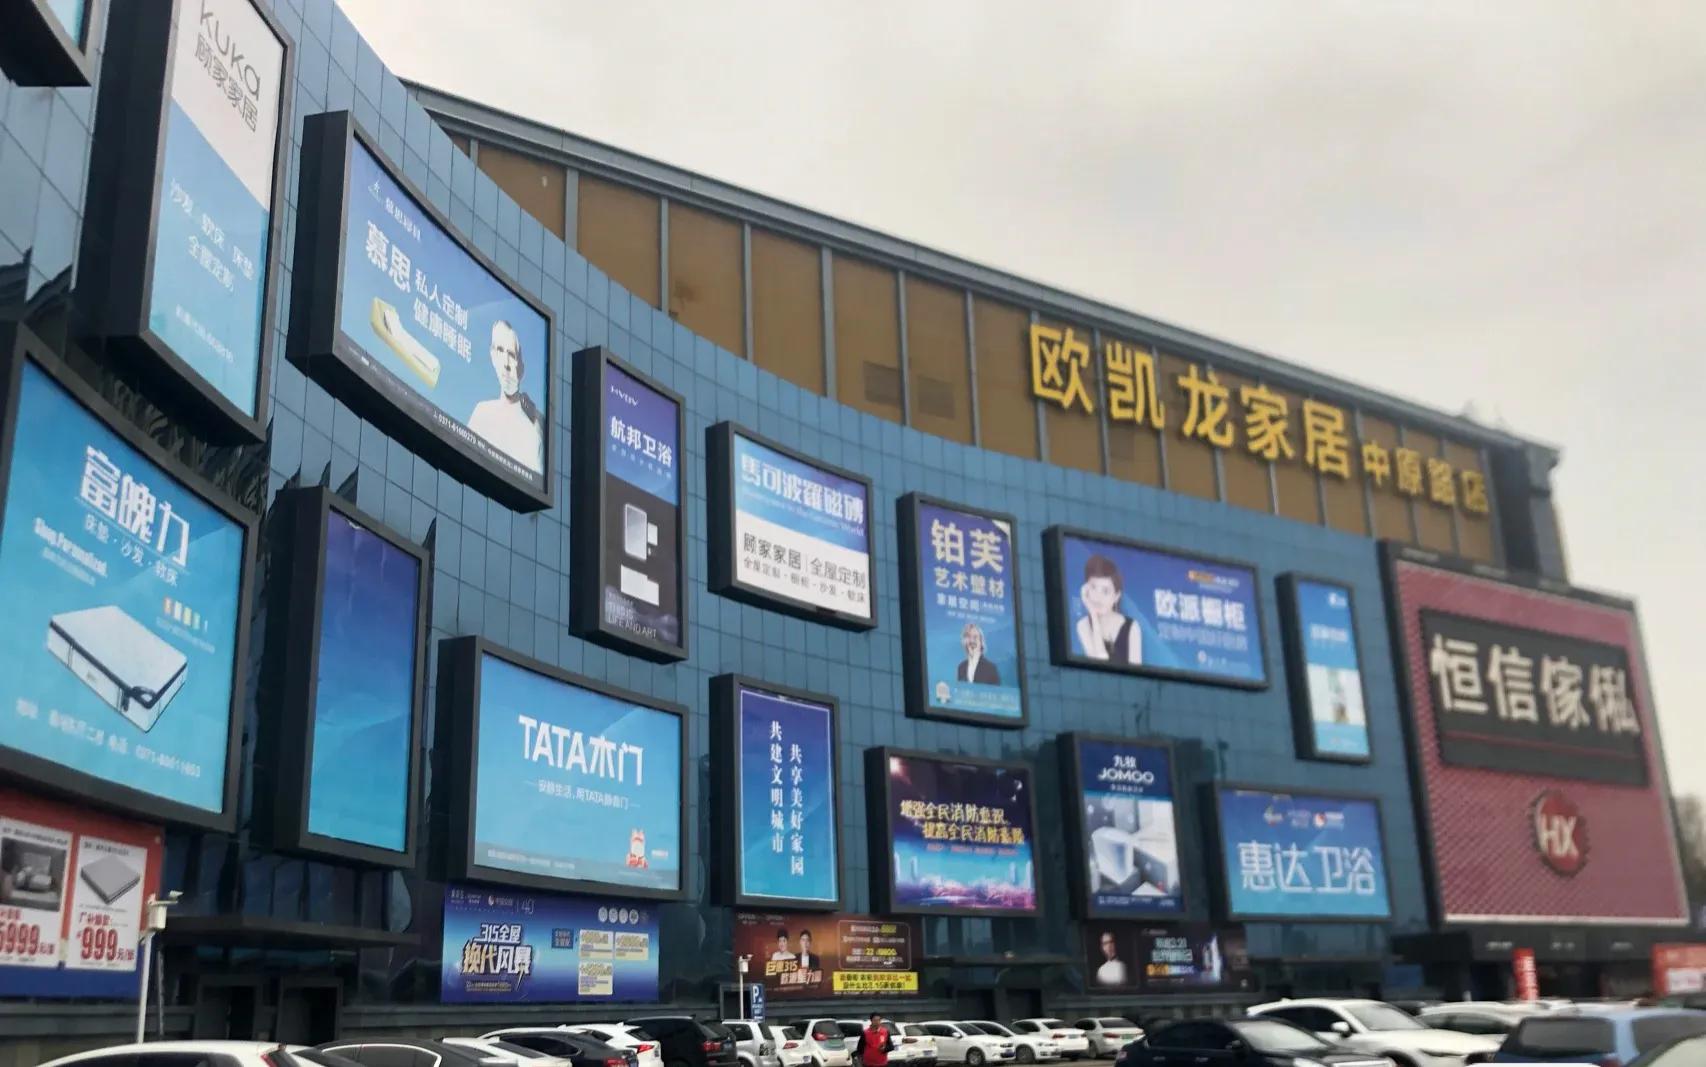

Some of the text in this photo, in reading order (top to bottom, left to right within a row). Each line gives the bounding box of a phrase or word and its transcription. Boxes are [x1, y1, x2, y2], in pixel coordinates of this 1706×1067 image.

[195, 32, 258, 133] 顾家家居
[366, 220, 412, 293] 慕思
[414, 297, 472, 363] 健康睡眠
[416, 268, 469, 331] 私人定制
[1029, 323, 1352, 481] 欧凯龙家居
[611, 415, 672, 468] 航邦卫浴
[80, 444, 190, 568] 富魄力
[743, 532, 866, 591] 顾家家居 全屋定制
[931, 518, 1004, 572] 铂芙
[934, 566, 1004, 599] 艺术壁材
[518, 714, 644, 787] TATA木门
[1098, 767, 1155, 785] JOMOO
[770, 720, 784, 854] 共建文明城市
[790, 743, 805, 876] 共享美好家园
[1237, 840, 1376, 896] 惠达卫浴
[473, 924, 522, 943] 315全屋
[752, 985, 760, 1003] P
